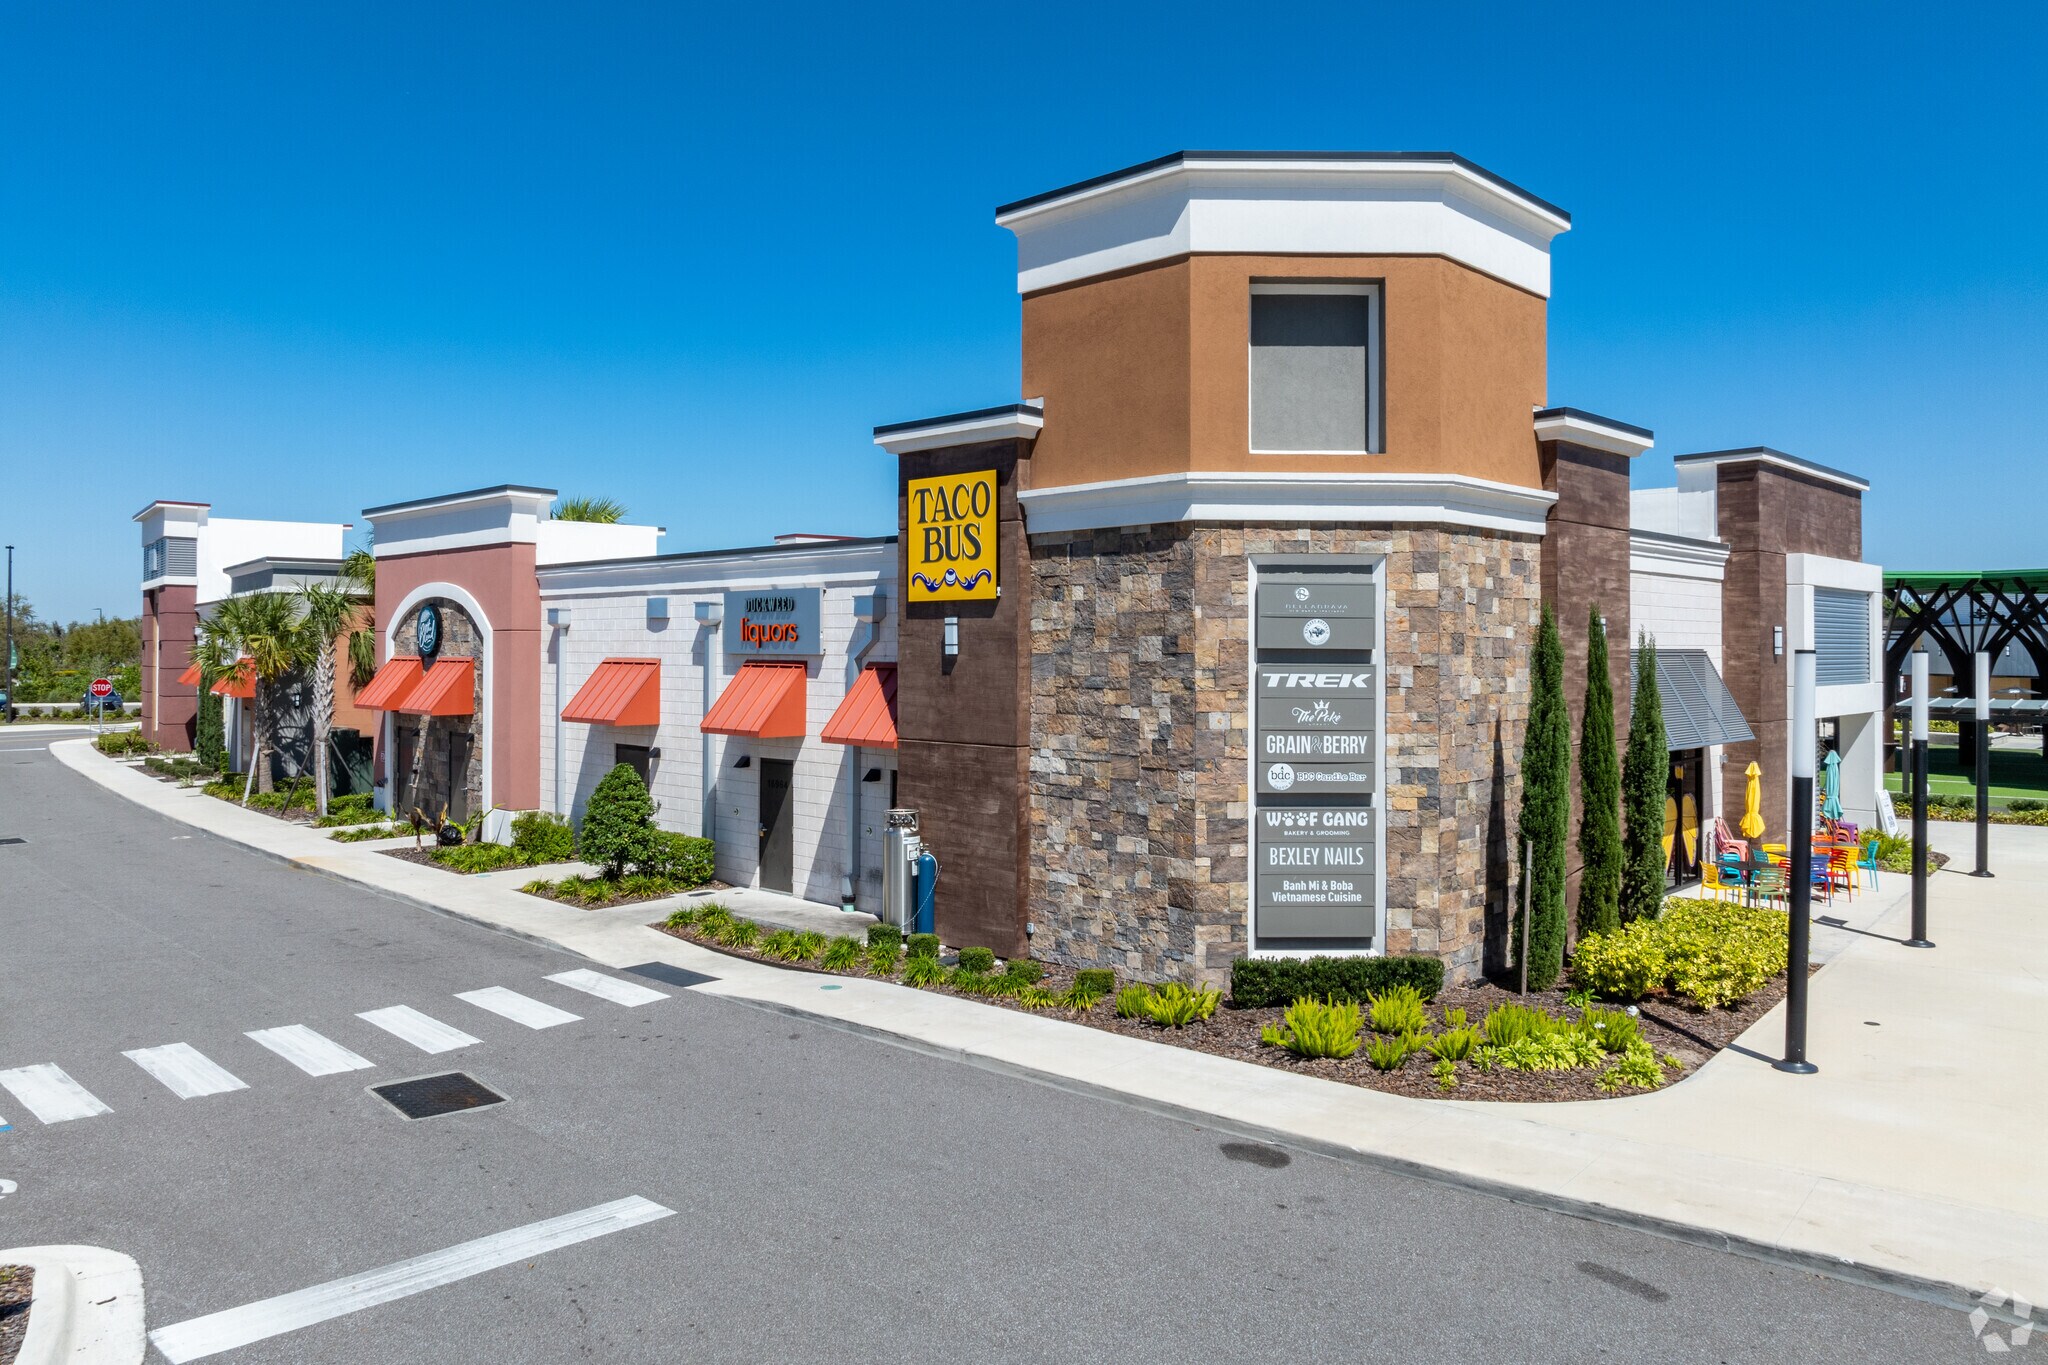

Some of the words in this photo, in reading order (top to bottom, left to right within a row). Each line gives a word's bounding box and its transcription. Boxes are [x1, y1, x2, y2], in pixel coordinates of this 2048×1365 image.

[912, 480, 991, 524] TACO
[921, 522, 982, 564] BUS
[745, 596, 796, 613] DUCKWEED
[741, 617, 799, 649] liquors
[1262, 673, 1372, 688] TREK
[1292, 707, 1315, 724] The
[1297, 772, 1315, 781] BDC
[1315, 771, 1349, 781] Candle
[1349, 772, 1367, 781] Bar
[1322, 812, 1368, 827] GANG
[1269, 847, 1320, 865] BEXLEY
[1324, 847, 1364, 865] NAILS
[1283, 880, 1307, 891] Banh
[1308, 880, 1320, 891] Mi
[1321, 881, 1328, 891] &
[1330, 881, 1354, 891] Boba
[1272, 891, 1327, 902] Vietnamese
[1328, 891, 1362, 902] Cuisine
